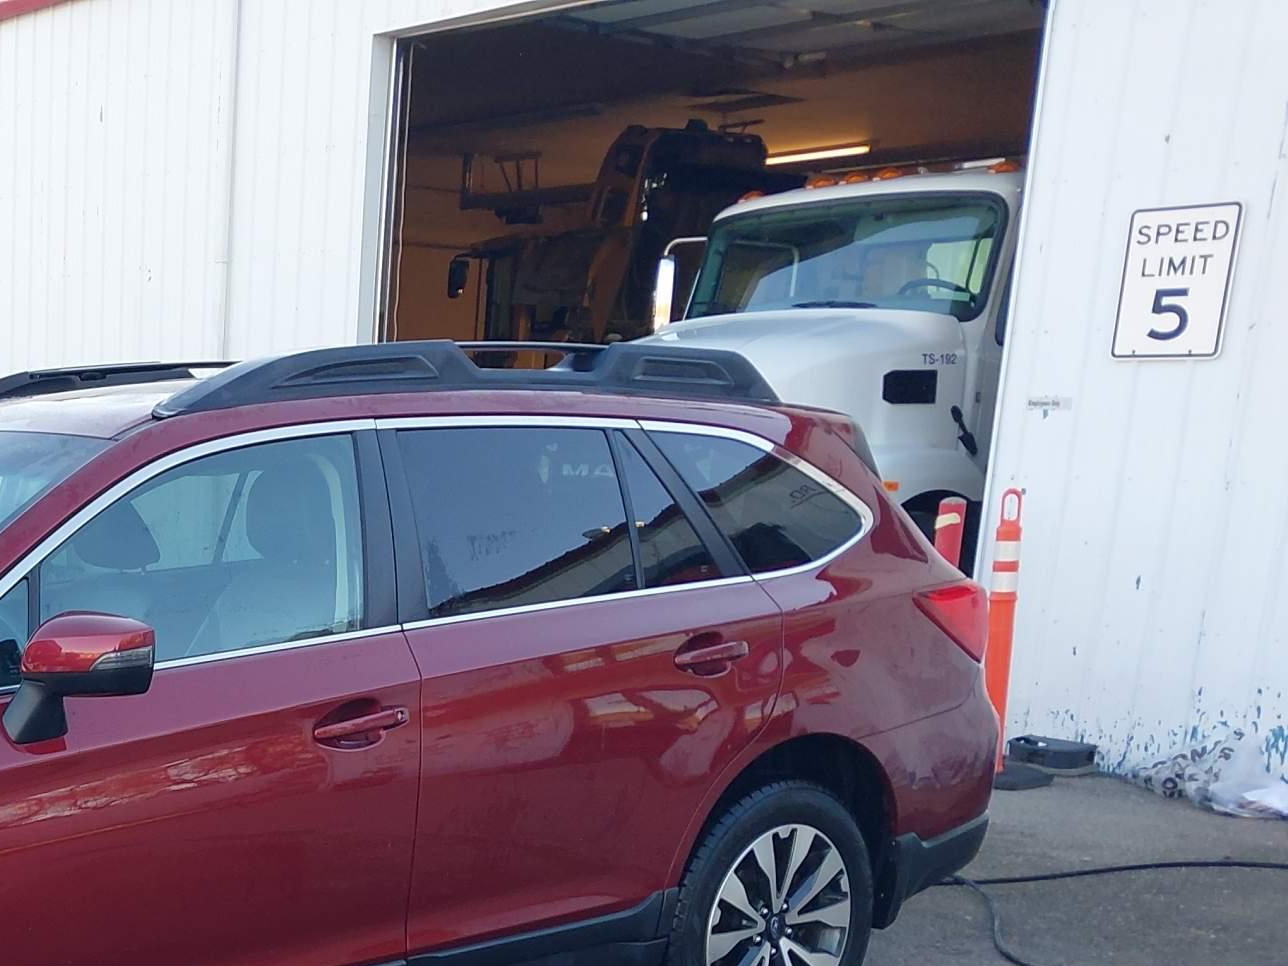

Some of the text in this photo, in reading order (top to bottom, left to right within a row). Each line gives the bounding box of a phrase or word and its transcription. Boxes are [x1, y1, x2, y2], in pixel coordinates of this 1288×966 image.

[1136, 220, 1230, 245] SPEED
[1141, 254, 1214, 277] LIMIT
[1146, 287, 1190, 341] 5
